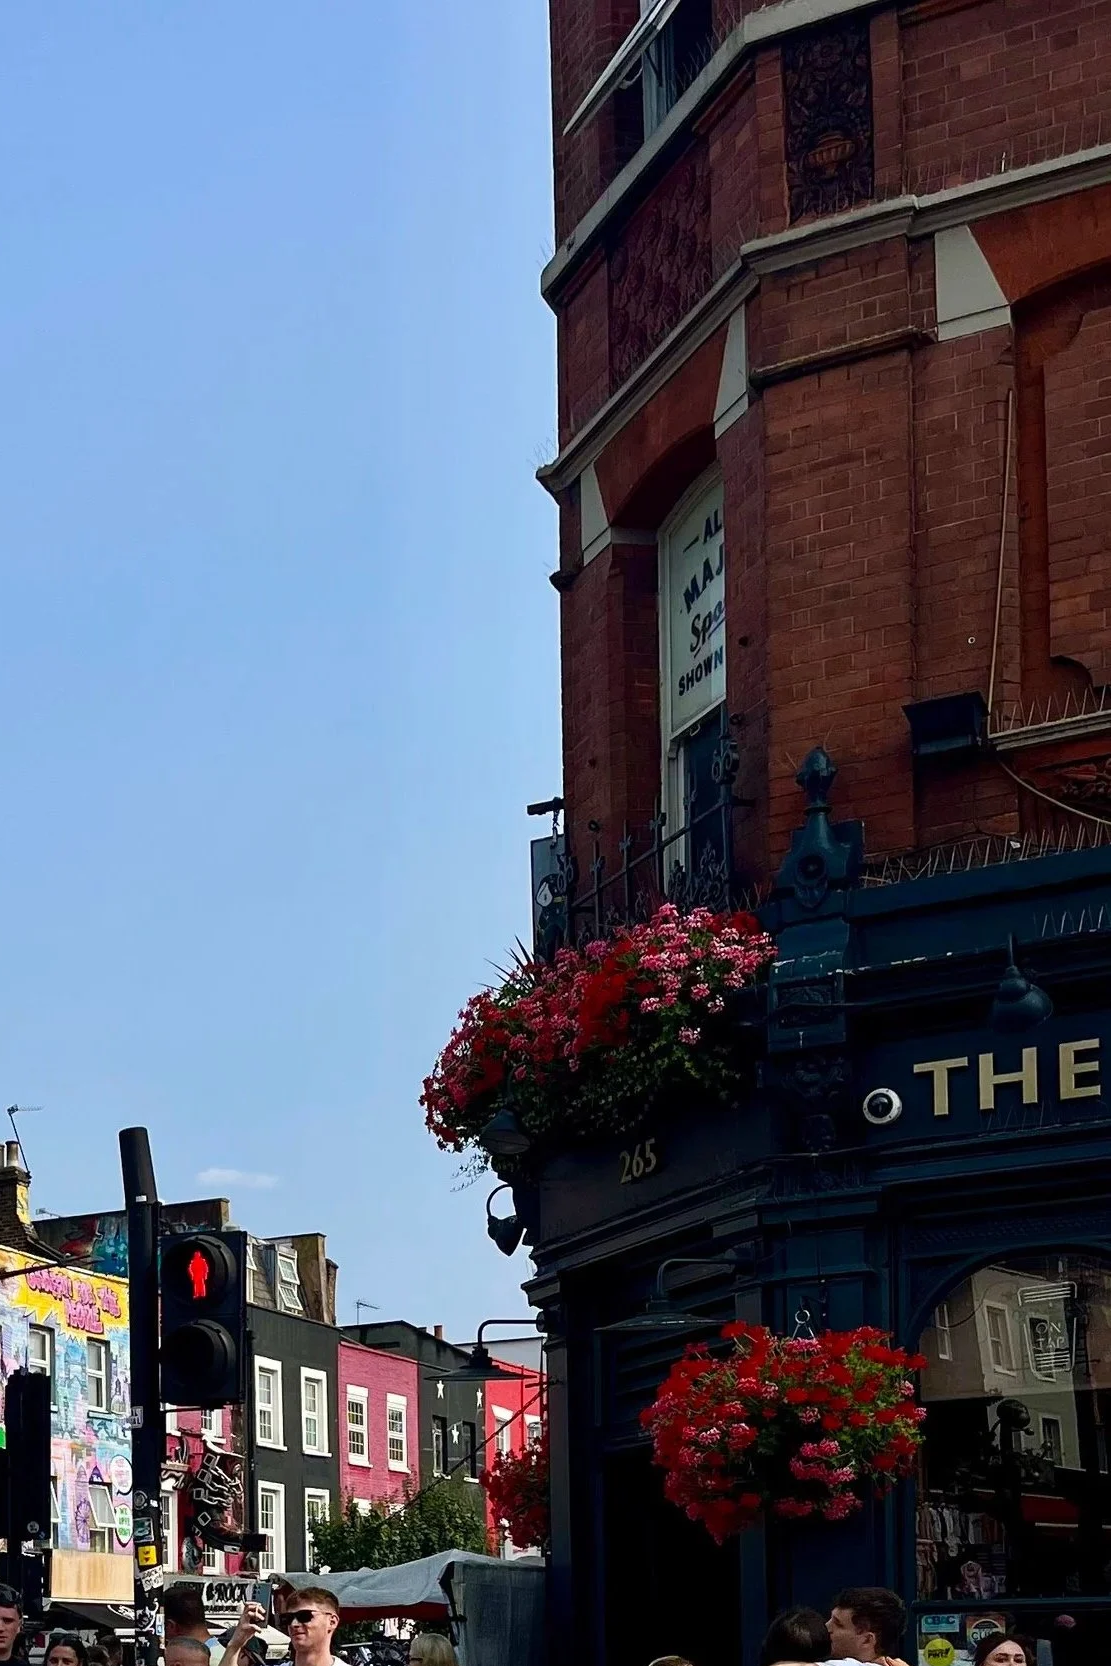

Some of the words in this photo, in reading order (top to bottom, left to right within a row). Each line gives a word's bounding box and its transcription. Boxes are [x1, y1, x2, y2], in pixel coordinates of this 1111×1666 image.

[678, 646, 724, 697] SHOWN
[913, 1038, 1101, 1117] THE
[620, 1138, 656, 1185] 265
